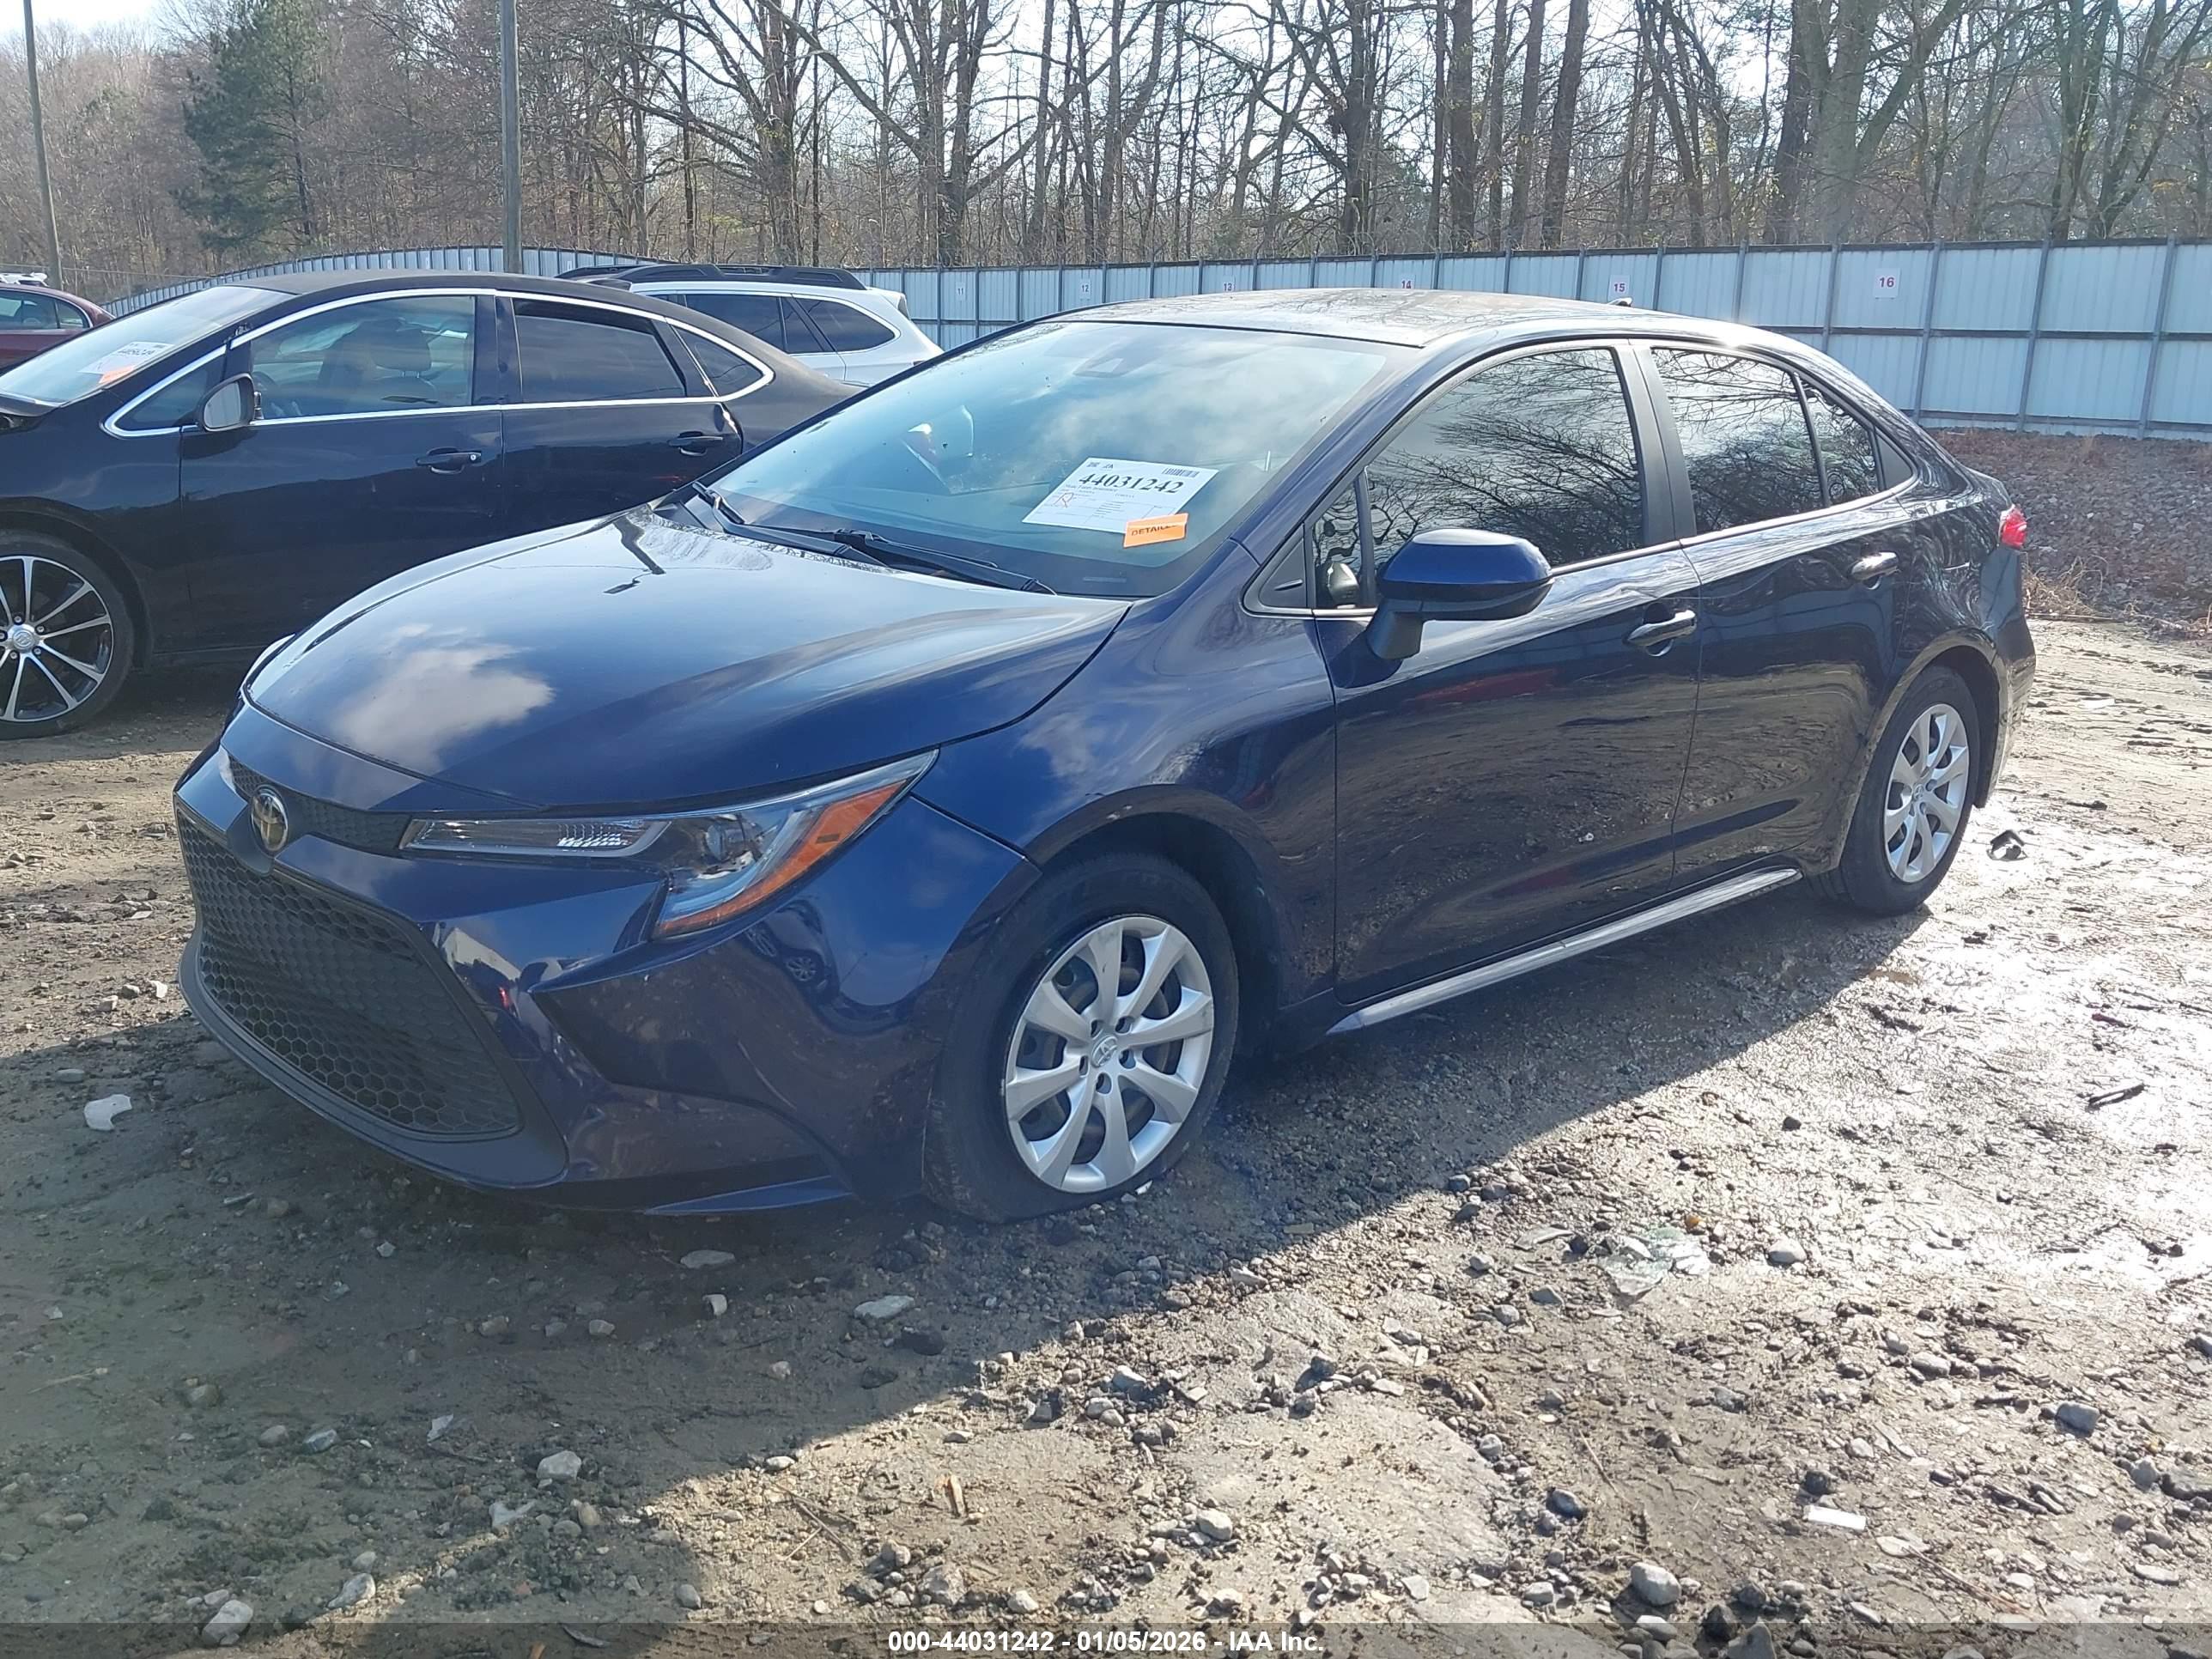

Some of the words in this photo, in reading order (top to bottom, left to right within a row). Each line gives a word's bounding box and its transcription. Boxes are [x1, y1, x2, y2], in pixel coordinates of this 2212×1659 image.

[1224, 283, 1233, 291] 13
[1401, 280, 1412, 289] 14
[1879, 276, 1895, 289] 16
[1081, 283, 1090, 293] 12
[1613, 283, 1626, 293] 15
[1079, 473, 1184, 494] 44031242
